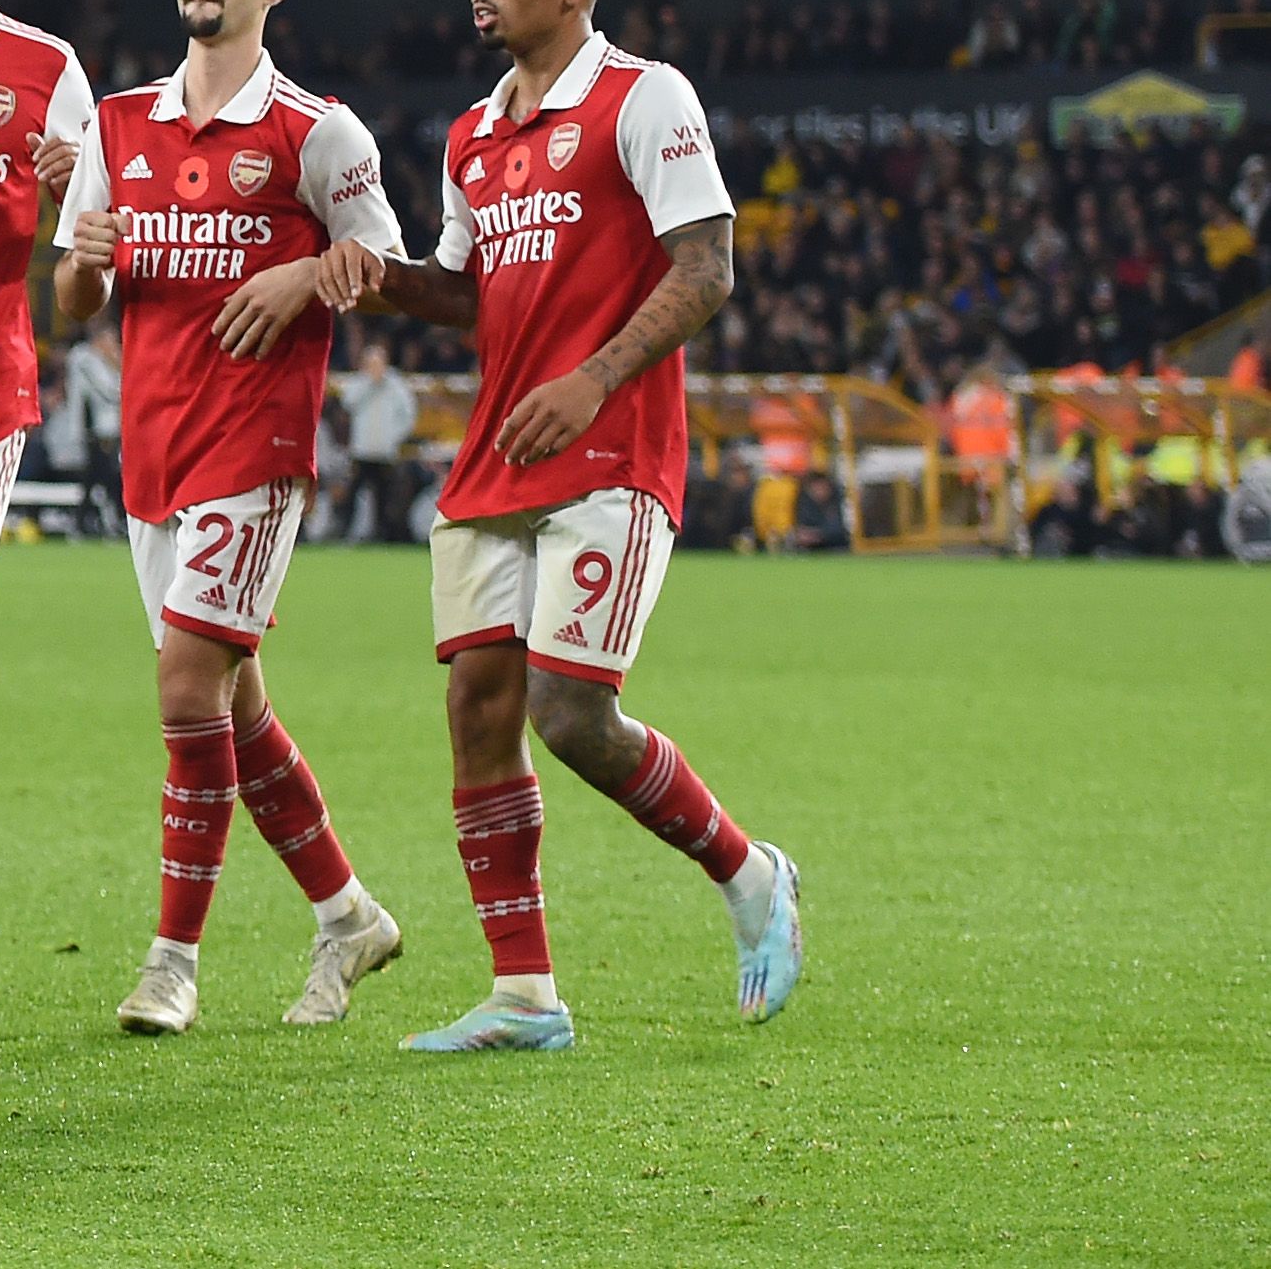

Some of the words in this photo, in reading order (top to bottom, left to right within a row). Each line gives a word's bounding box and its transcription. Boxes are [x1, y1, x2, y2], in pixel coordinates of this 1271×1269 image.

[132, 248, 163, 279] FLY
[167, 248, 246, 280] BETTER
[186, 513, 254, 586] 21
[572, 551, 612, 615] 9
[164, 813, 208, 834] AFC
